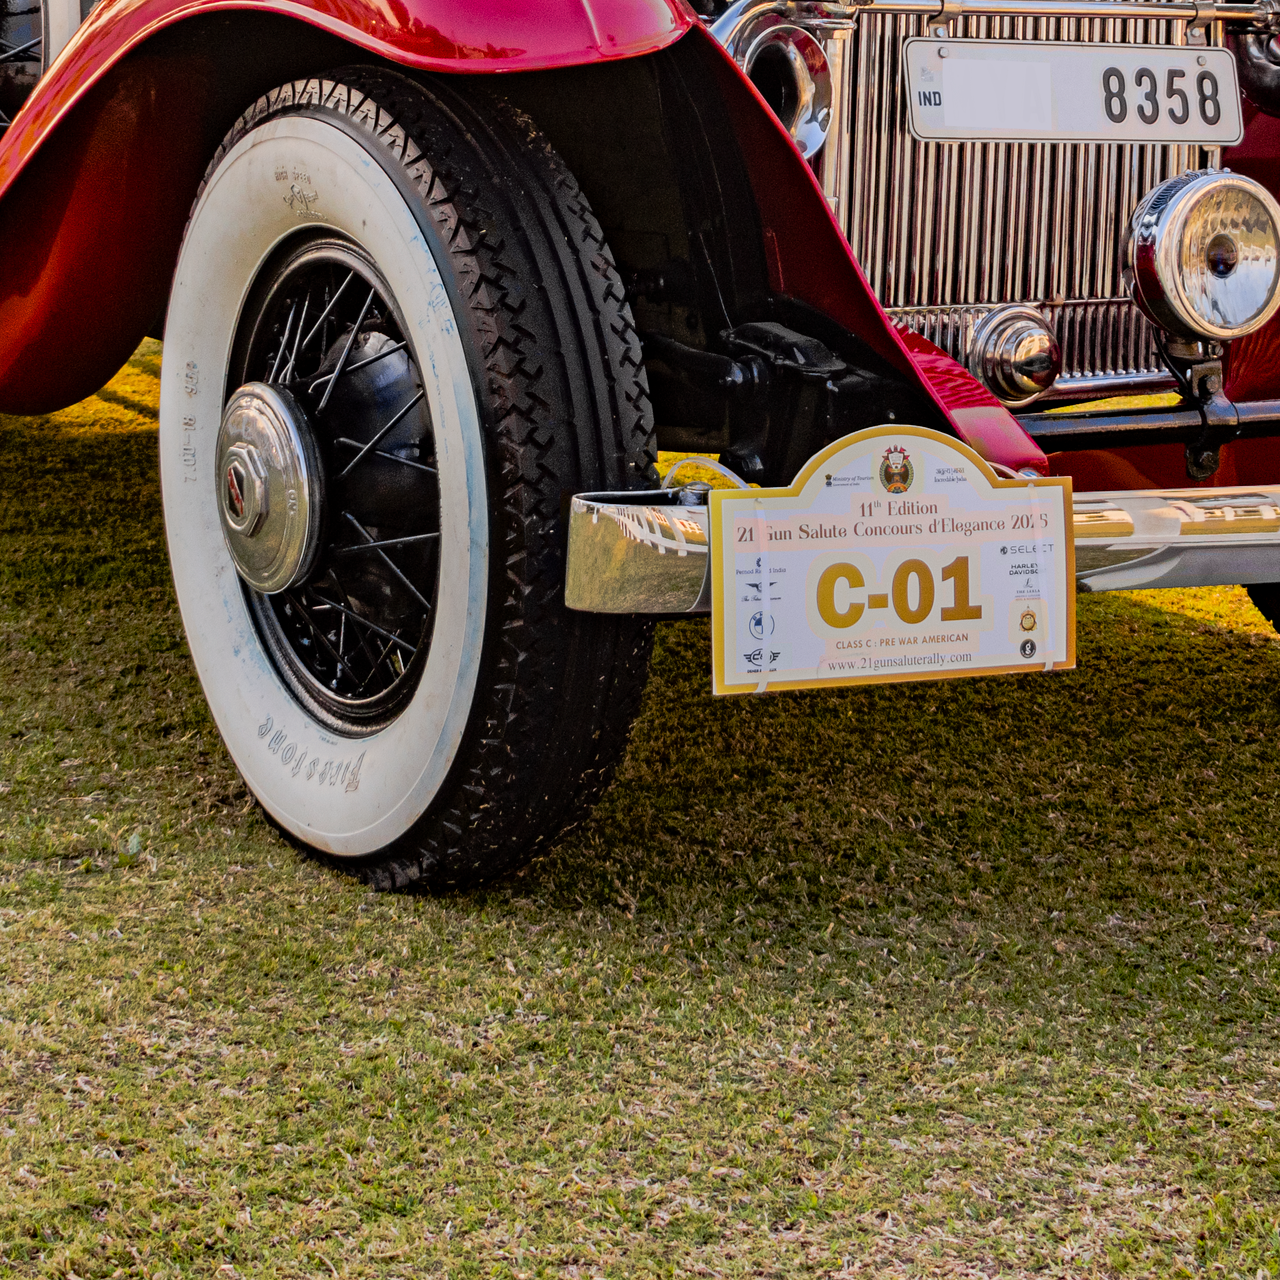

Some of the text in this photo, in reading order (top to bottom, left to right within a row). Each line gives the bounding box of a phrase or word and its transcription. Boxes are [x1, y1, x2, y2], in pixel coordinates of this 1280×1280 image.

[918, 91, 942, 106] IND
[1103, 67, 1220, 125] 8358
[860, 500, 938, 517] 11th Edition
[737, 526, 754, 542] 21
[798, 523, 847, 540] Salute
[853, 521, 923, 537] Concours
[928, 518, 1005, 536] d'Elegance
[817, 556, 982, 629] C-01
[836, 640, 863, 649] CLASS
[866, 639, 872, 648] C
[880, 638, 895, 647] PRE
[899, 637, 918, 645] WAR
[922, 633, 969, 644] AMERICAN
[828, 652, 972, 671] www.21gunsaluterally.com
